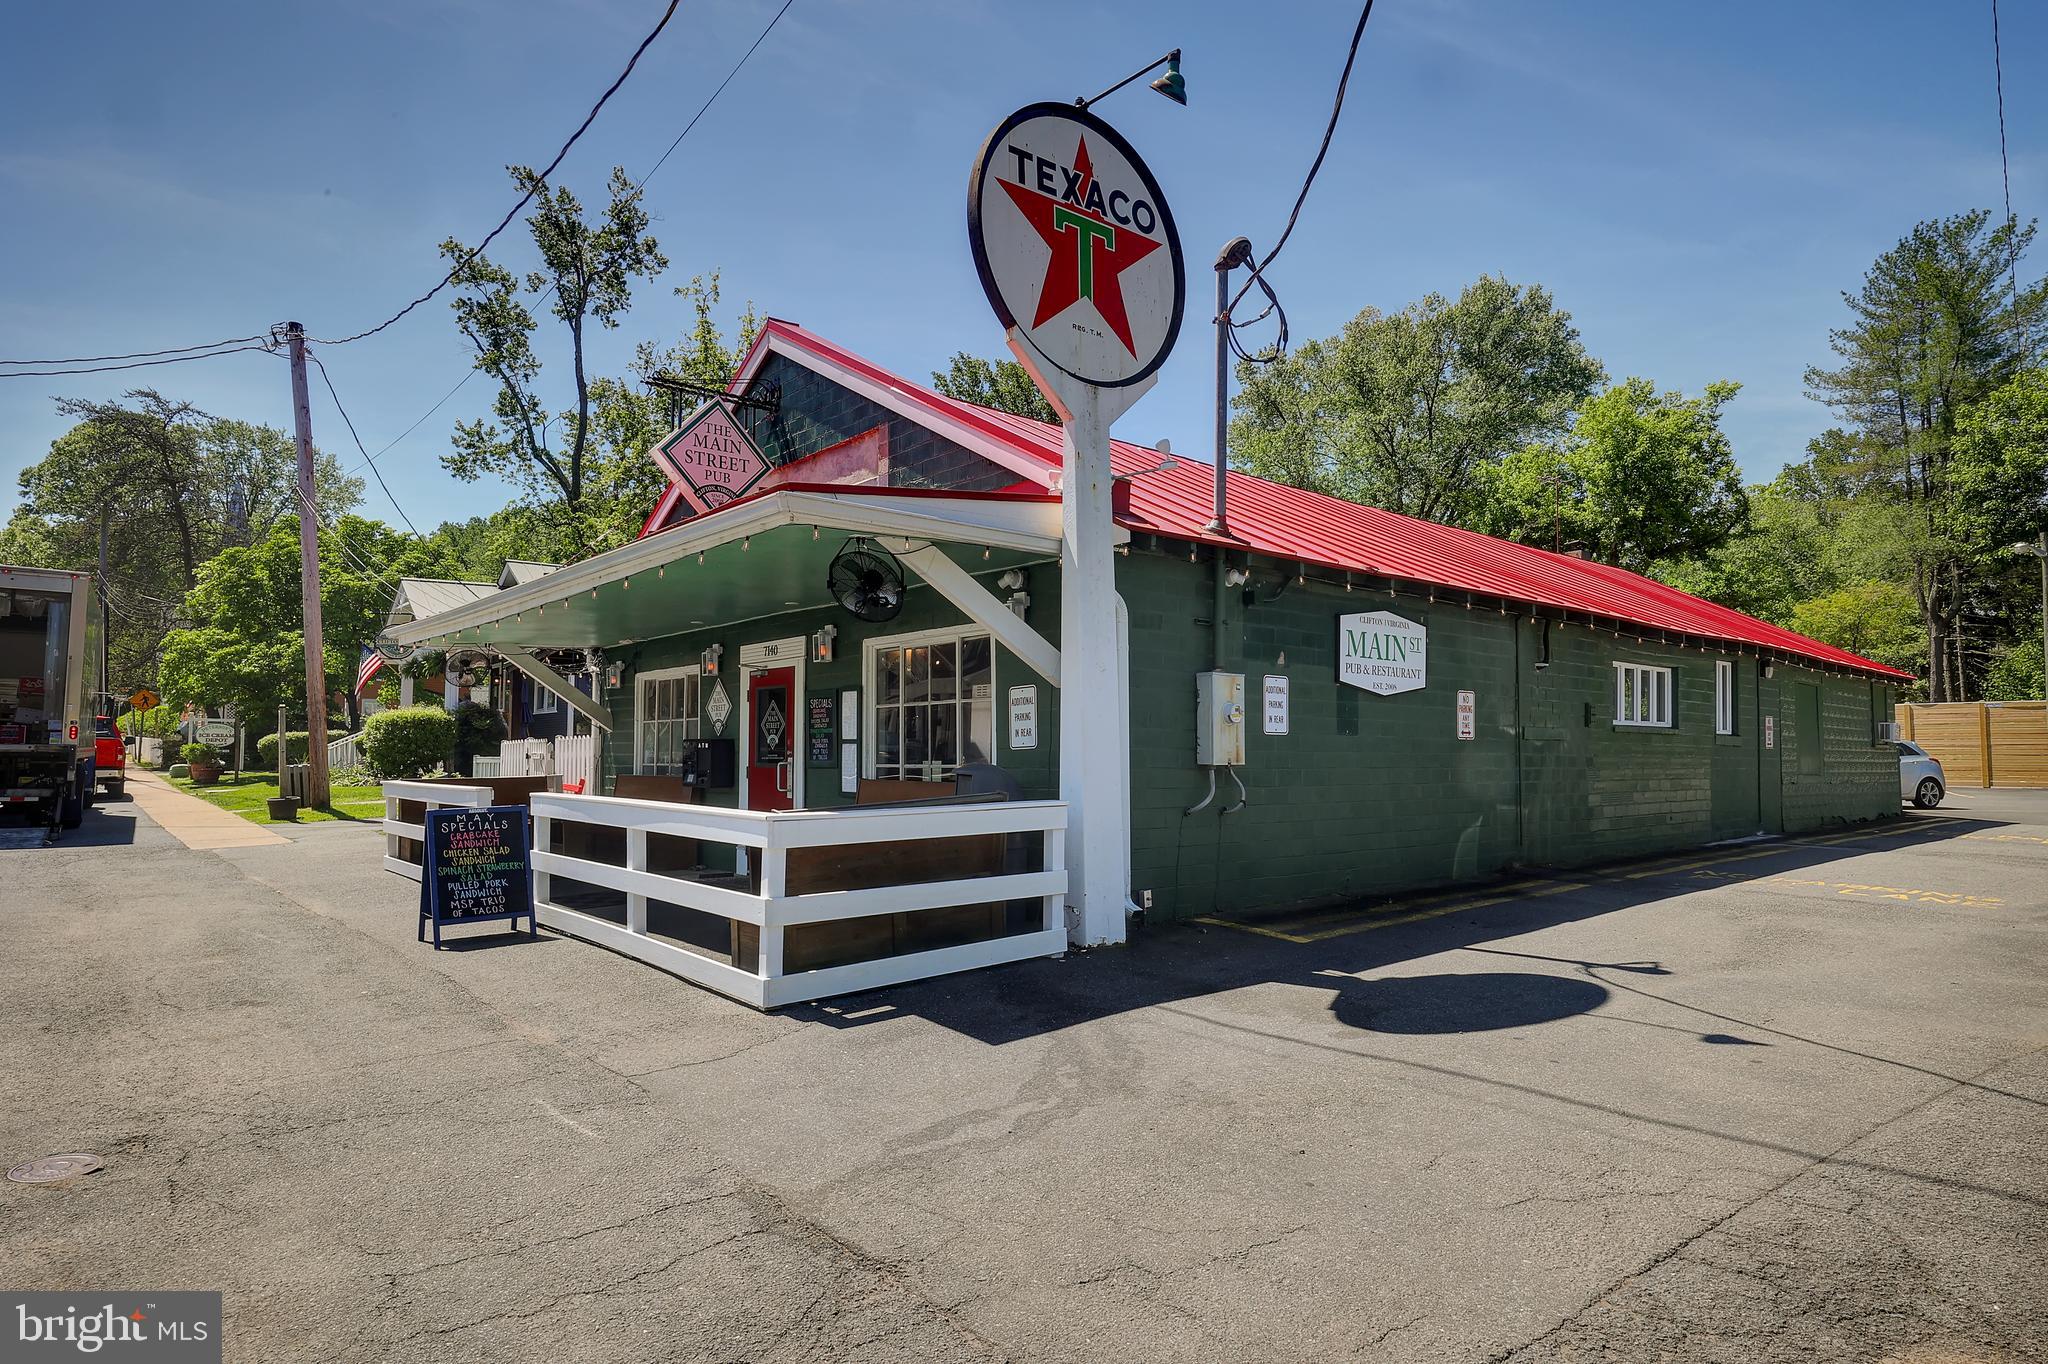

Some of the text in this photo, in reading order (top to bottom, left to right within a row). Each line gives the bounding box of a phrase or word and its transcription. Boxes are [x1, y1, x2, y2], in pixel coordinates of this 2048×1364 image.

[1008, 144, 1156, 235] TEXACO
[1054, 205, 1115, 303] T
[1072, 323, 1104, 339] REG. T.M.
[703, 422, 732, 438] THE
[693, 432, 742, 455] MAIN
[684, 449, 750, 473] STREET
[704, 469, 731, 484] PUB
[1360, 616, 1410, 630] CLIFTON VIRGINIA
[763, 645, 779, 657] 7140
[1345, 629, 1422, 663] MAIN ST
[1345, 662, 1422, 680] PUB & RESTAURANT
[1265, 685, 1287, 695] ADDITIONAL
[1384, 682, 1398, 691] 2008
[712, 696, 725, 704] MAIN
[810, 698, 833, 709] SPECIALS
[1011, 696, 1034, 706] ADDITIONAL
[1268, 700, 1284, 709] PARKING
[1462, 695, 1470, 704] NO
[711, 704, 726, 712] STREET
[1459, 704, 1473, 714] PARKING
[1014, 711, 1032, 722] PARKING
[1269, 714, 1284, 724] IN REAR
[1462, 721, 1471, 729] TIME
[1014, 727, 1033, 738] IN REAR
[456, 813, 494, 822] MAY
[441, 820, 508, 833] SPECIALS
[450, 830, 500, 841] CRABCAKE
[450, 838, 500, 849] SANDWICH
[443, 846, 510, 858] CHICKEN SALAD
[451, 855, 496, 867] SANDWICH
[438, 861, 525, 876] SPINACH STRAWBERRY
[460, 872, 493, 882] SALAD
[447, 878, 509, 891] PULLED PORK
[453, 887, 502, 900] SANDWICH
[450, 895, 506, 909] MSP TRIO
[452, 905, 505, 918] OF TACOS
